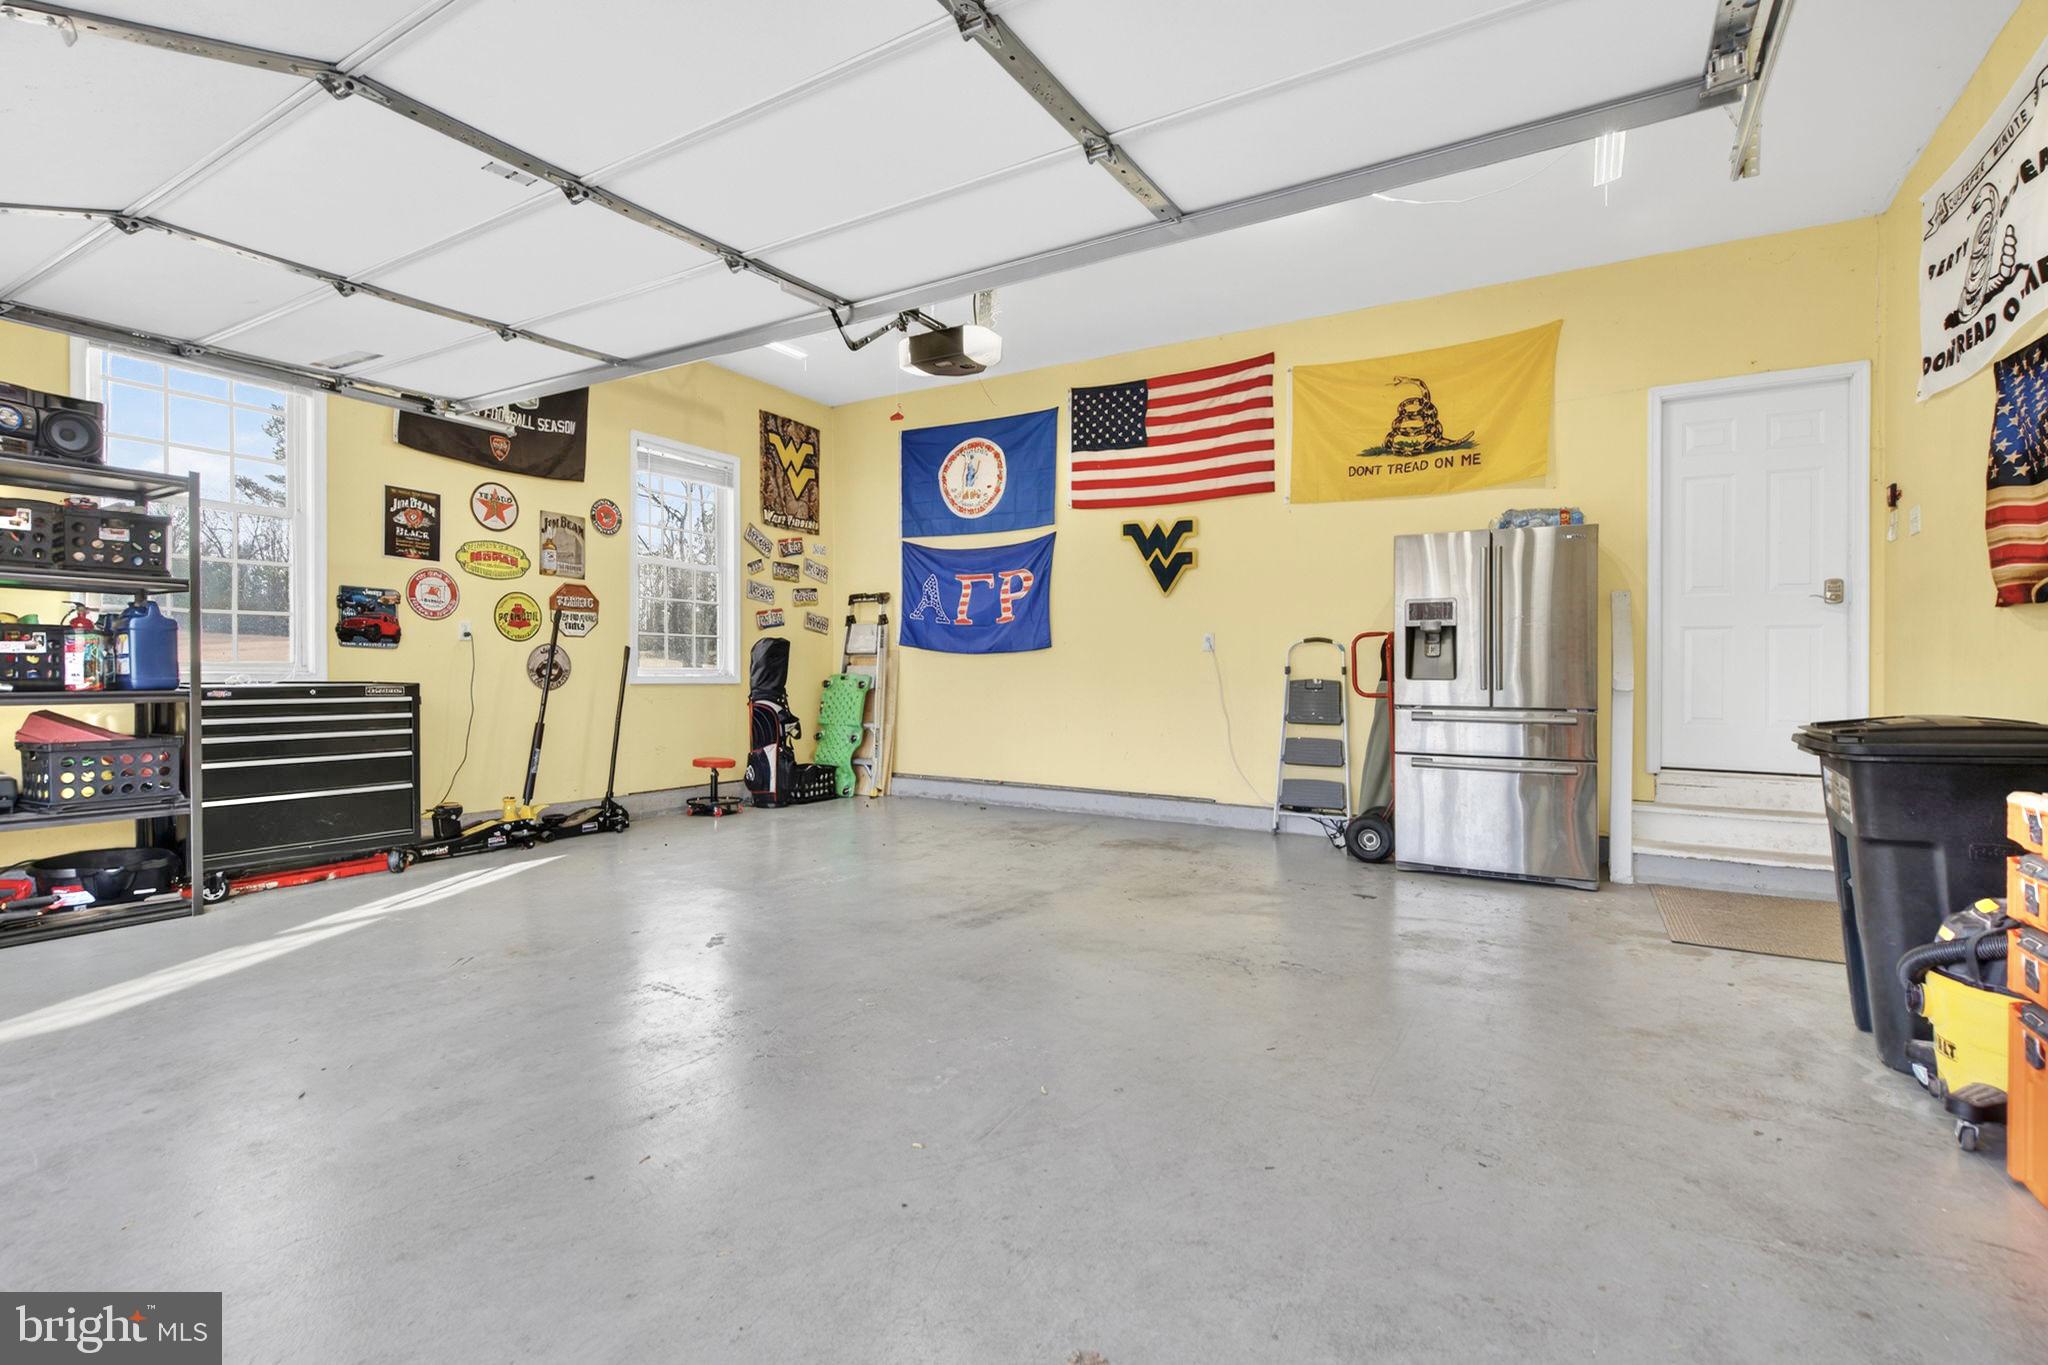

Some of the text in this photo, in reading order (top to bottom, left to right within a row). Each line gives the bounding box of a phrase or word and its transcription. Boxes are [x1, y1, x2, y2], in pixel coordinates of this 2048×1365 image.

[1348, 453, 1481, 477] DONT TREAD ON ME
[395, 526, 430, 540] BLACK
[541, 516, 560, 534] JIM
[560, 515, 585, 541] BEAM
